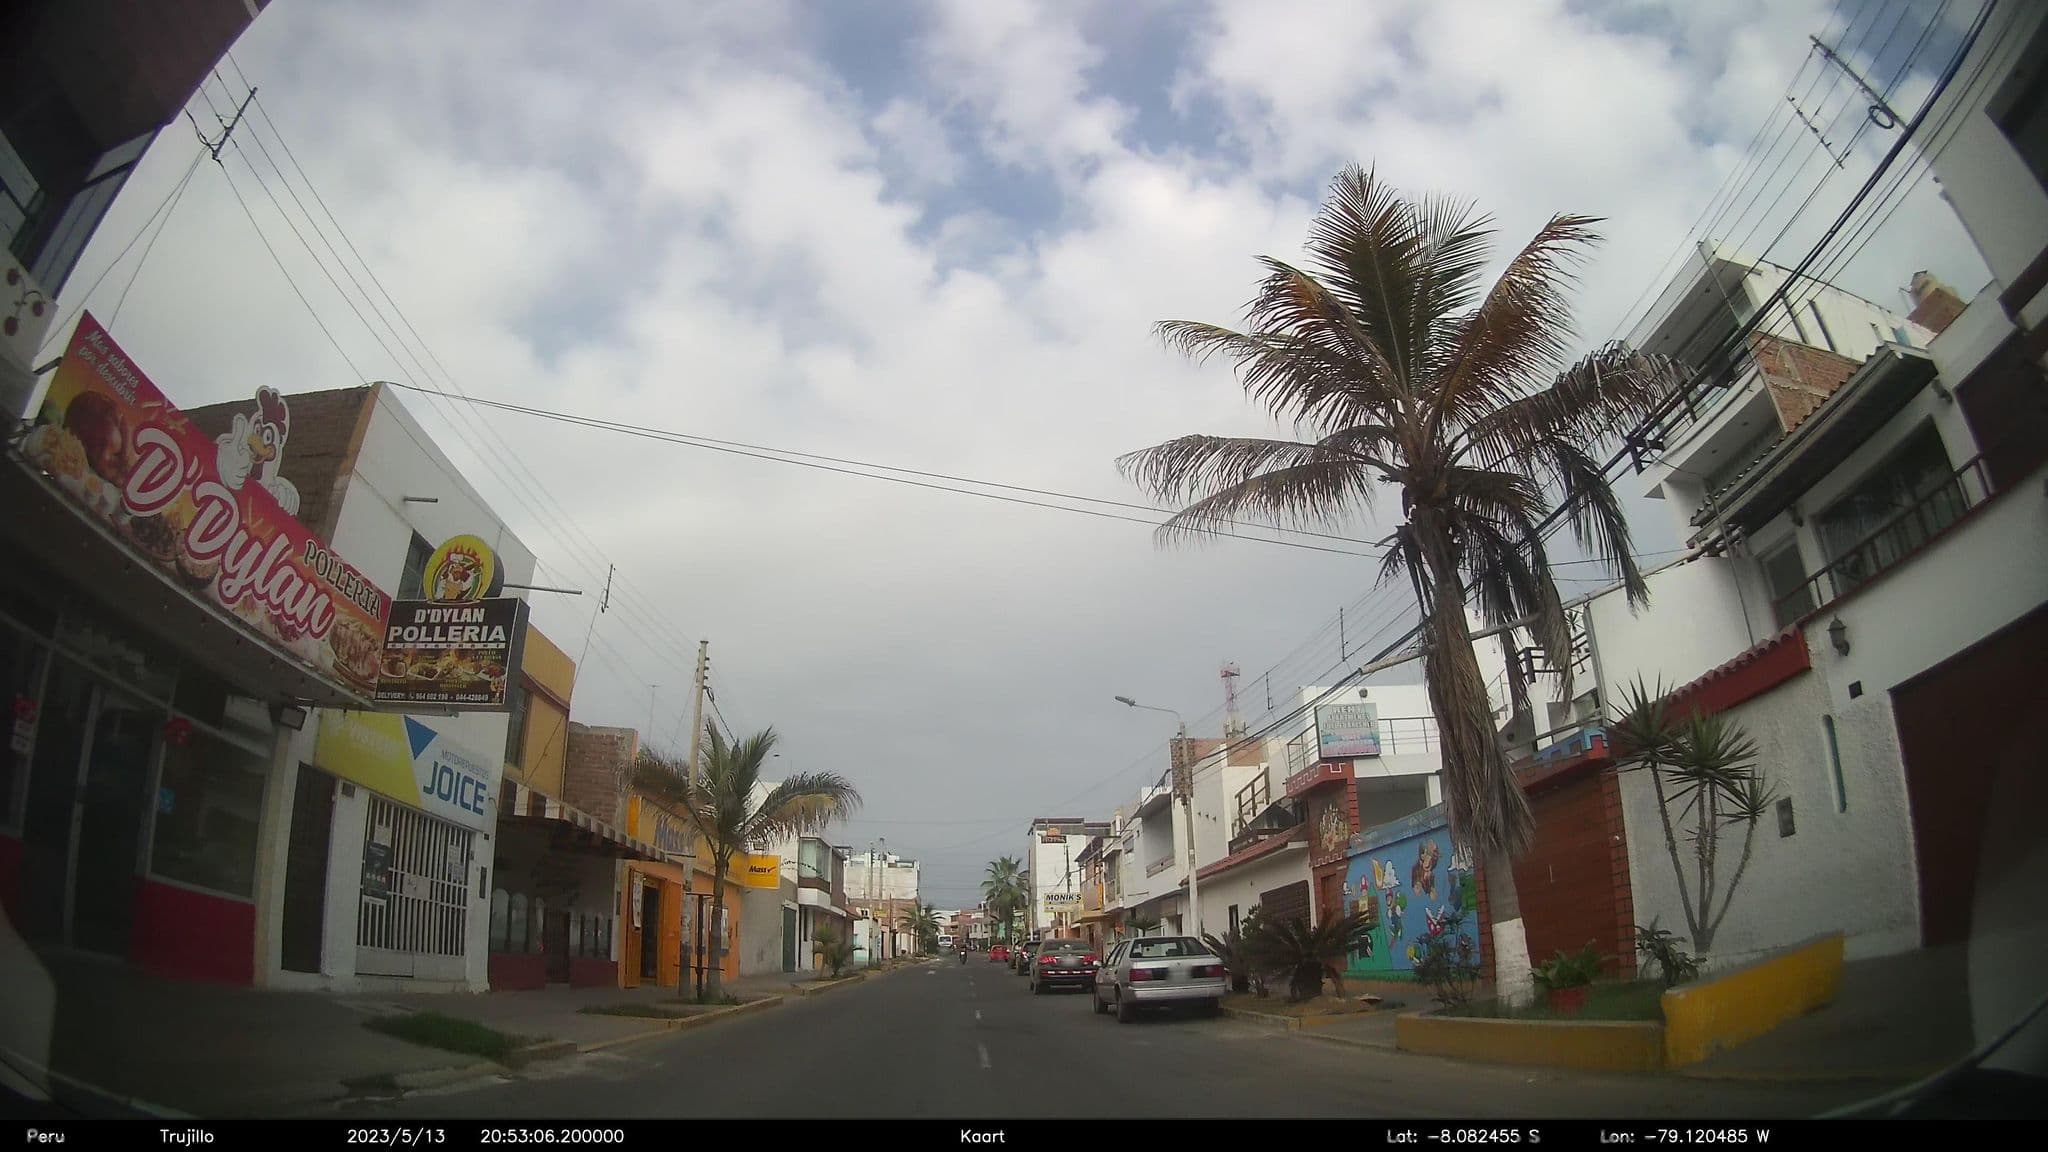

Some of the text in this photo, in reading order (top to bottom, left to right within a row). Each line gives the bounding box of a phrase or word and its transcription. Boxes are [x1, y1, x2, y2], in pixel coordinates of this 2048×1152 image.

[108, 354, 139, 388] sabores
[304, 540, 382, 621] POLLERIA
[414, 608, 486, 623] D'DYLAN
[388, 625, 506, 642] POLLERIA
[423, 760, 487, 816] JOICE
